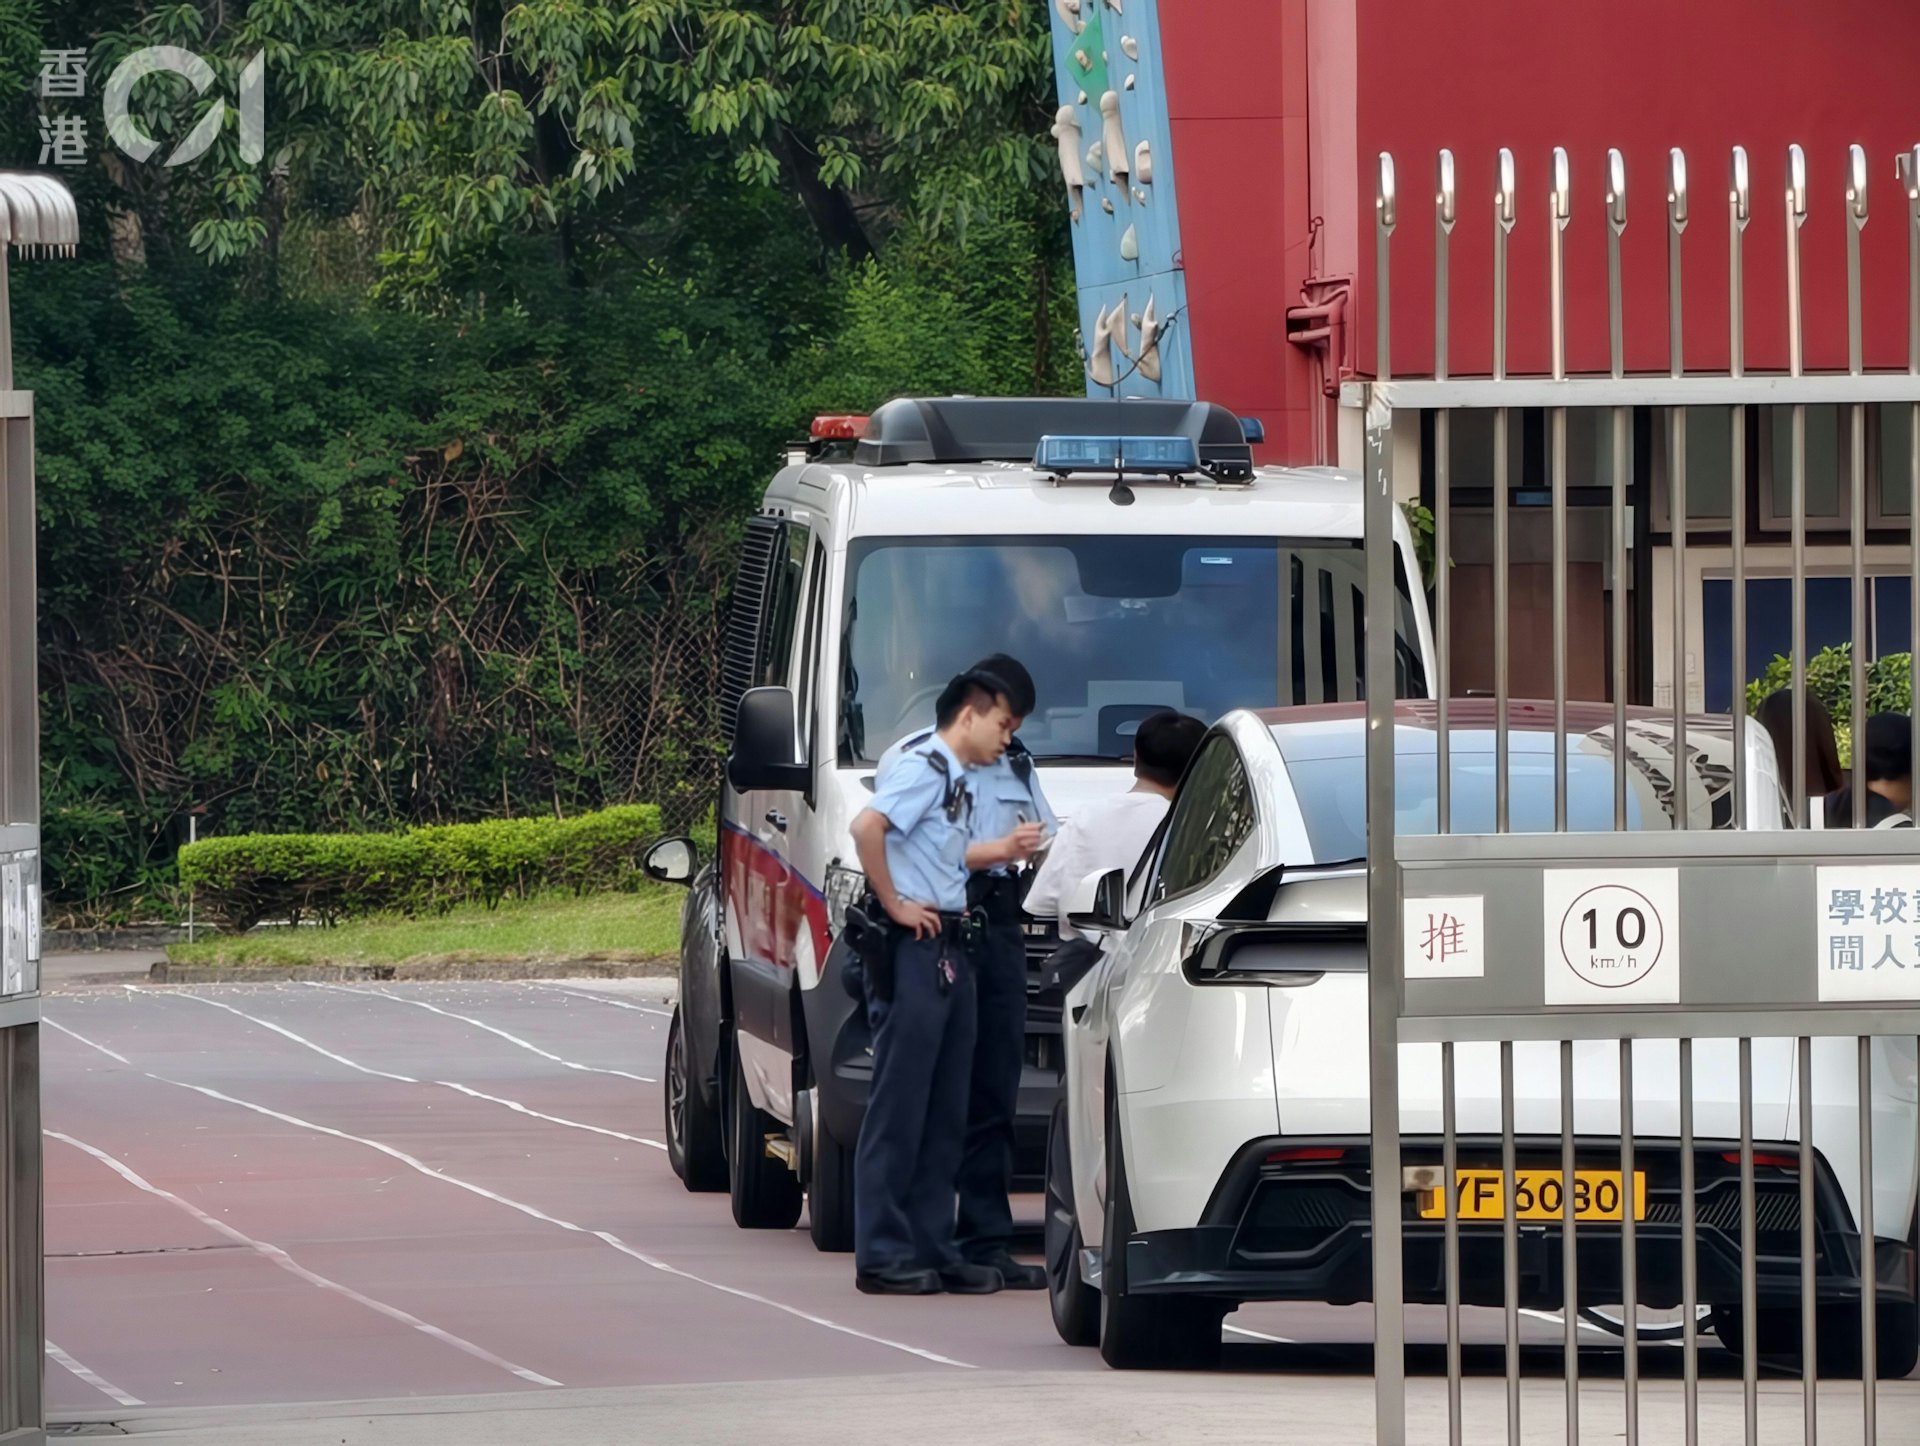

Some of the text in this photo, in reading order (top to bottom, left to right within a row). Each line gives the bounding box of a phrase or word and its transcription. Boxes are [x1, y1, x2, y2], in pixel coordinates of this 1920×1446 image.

[1828, 887, 1920, 925] 學校
[1419, 913, 1468, 963] 推
[1582, 907, 1646, 950] 10
[1590, 954, 1637, 969] km/h
[1829, 934, 1920, 970] 閒人
